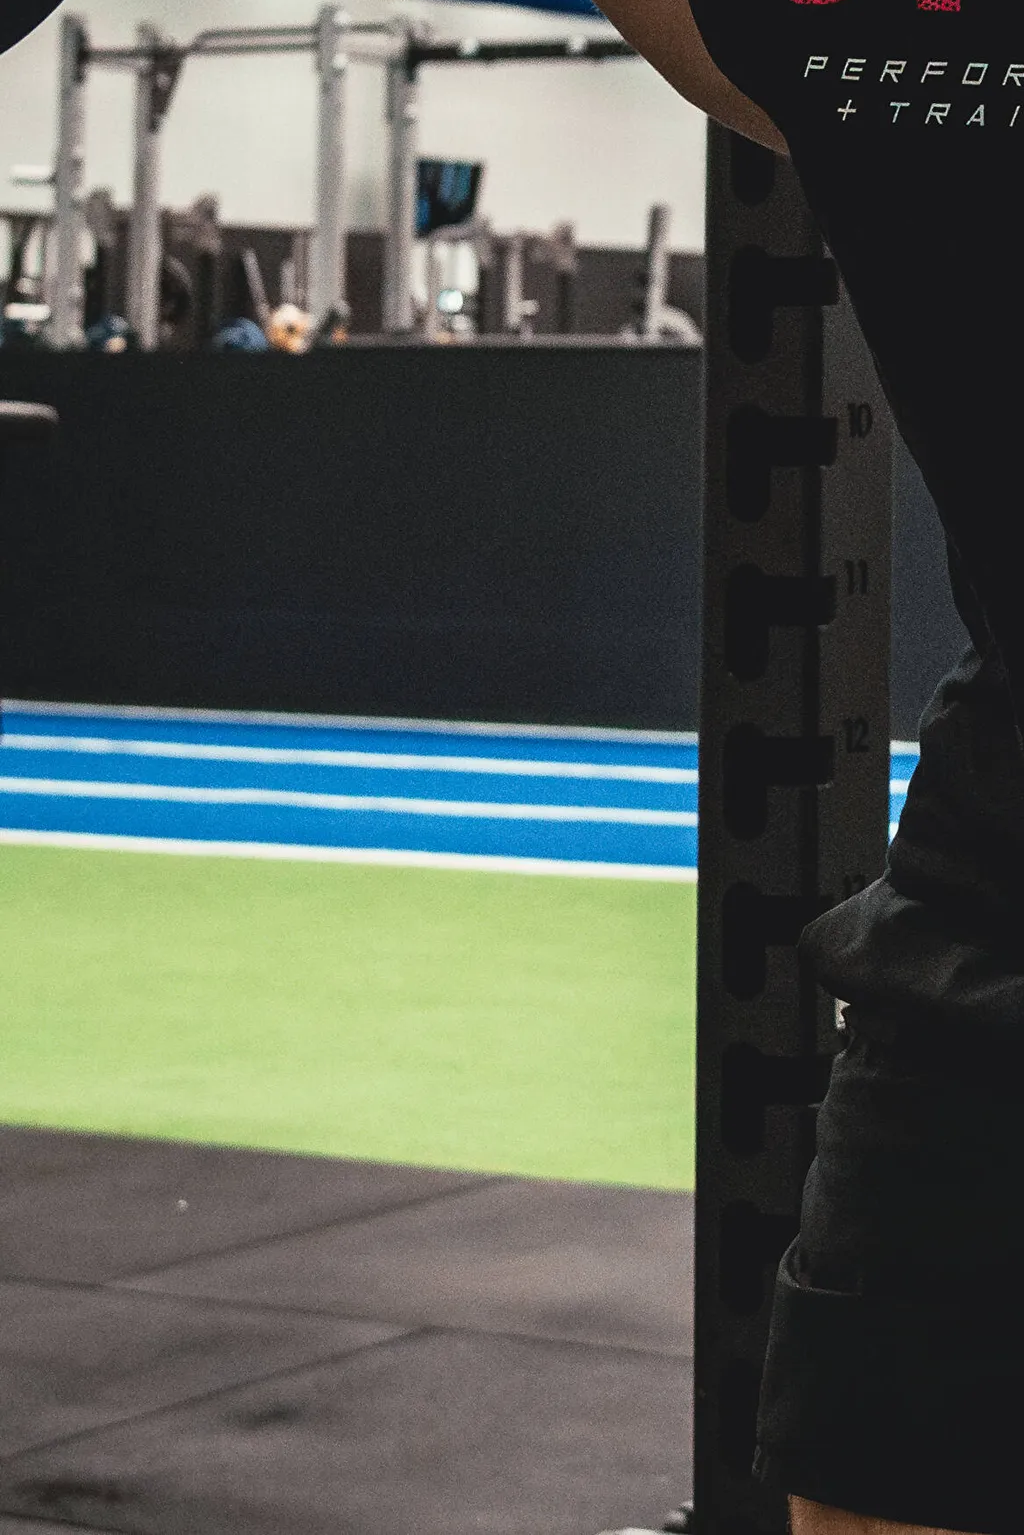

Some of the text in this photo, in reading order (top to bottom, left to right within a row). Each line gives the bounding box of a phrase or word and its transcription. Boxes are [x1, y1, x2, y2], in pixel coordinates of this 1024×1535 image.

[847, 402, 873, 438] 10
[844, 559, 868, 595] 11
[843, 716, 870, 753] 12
